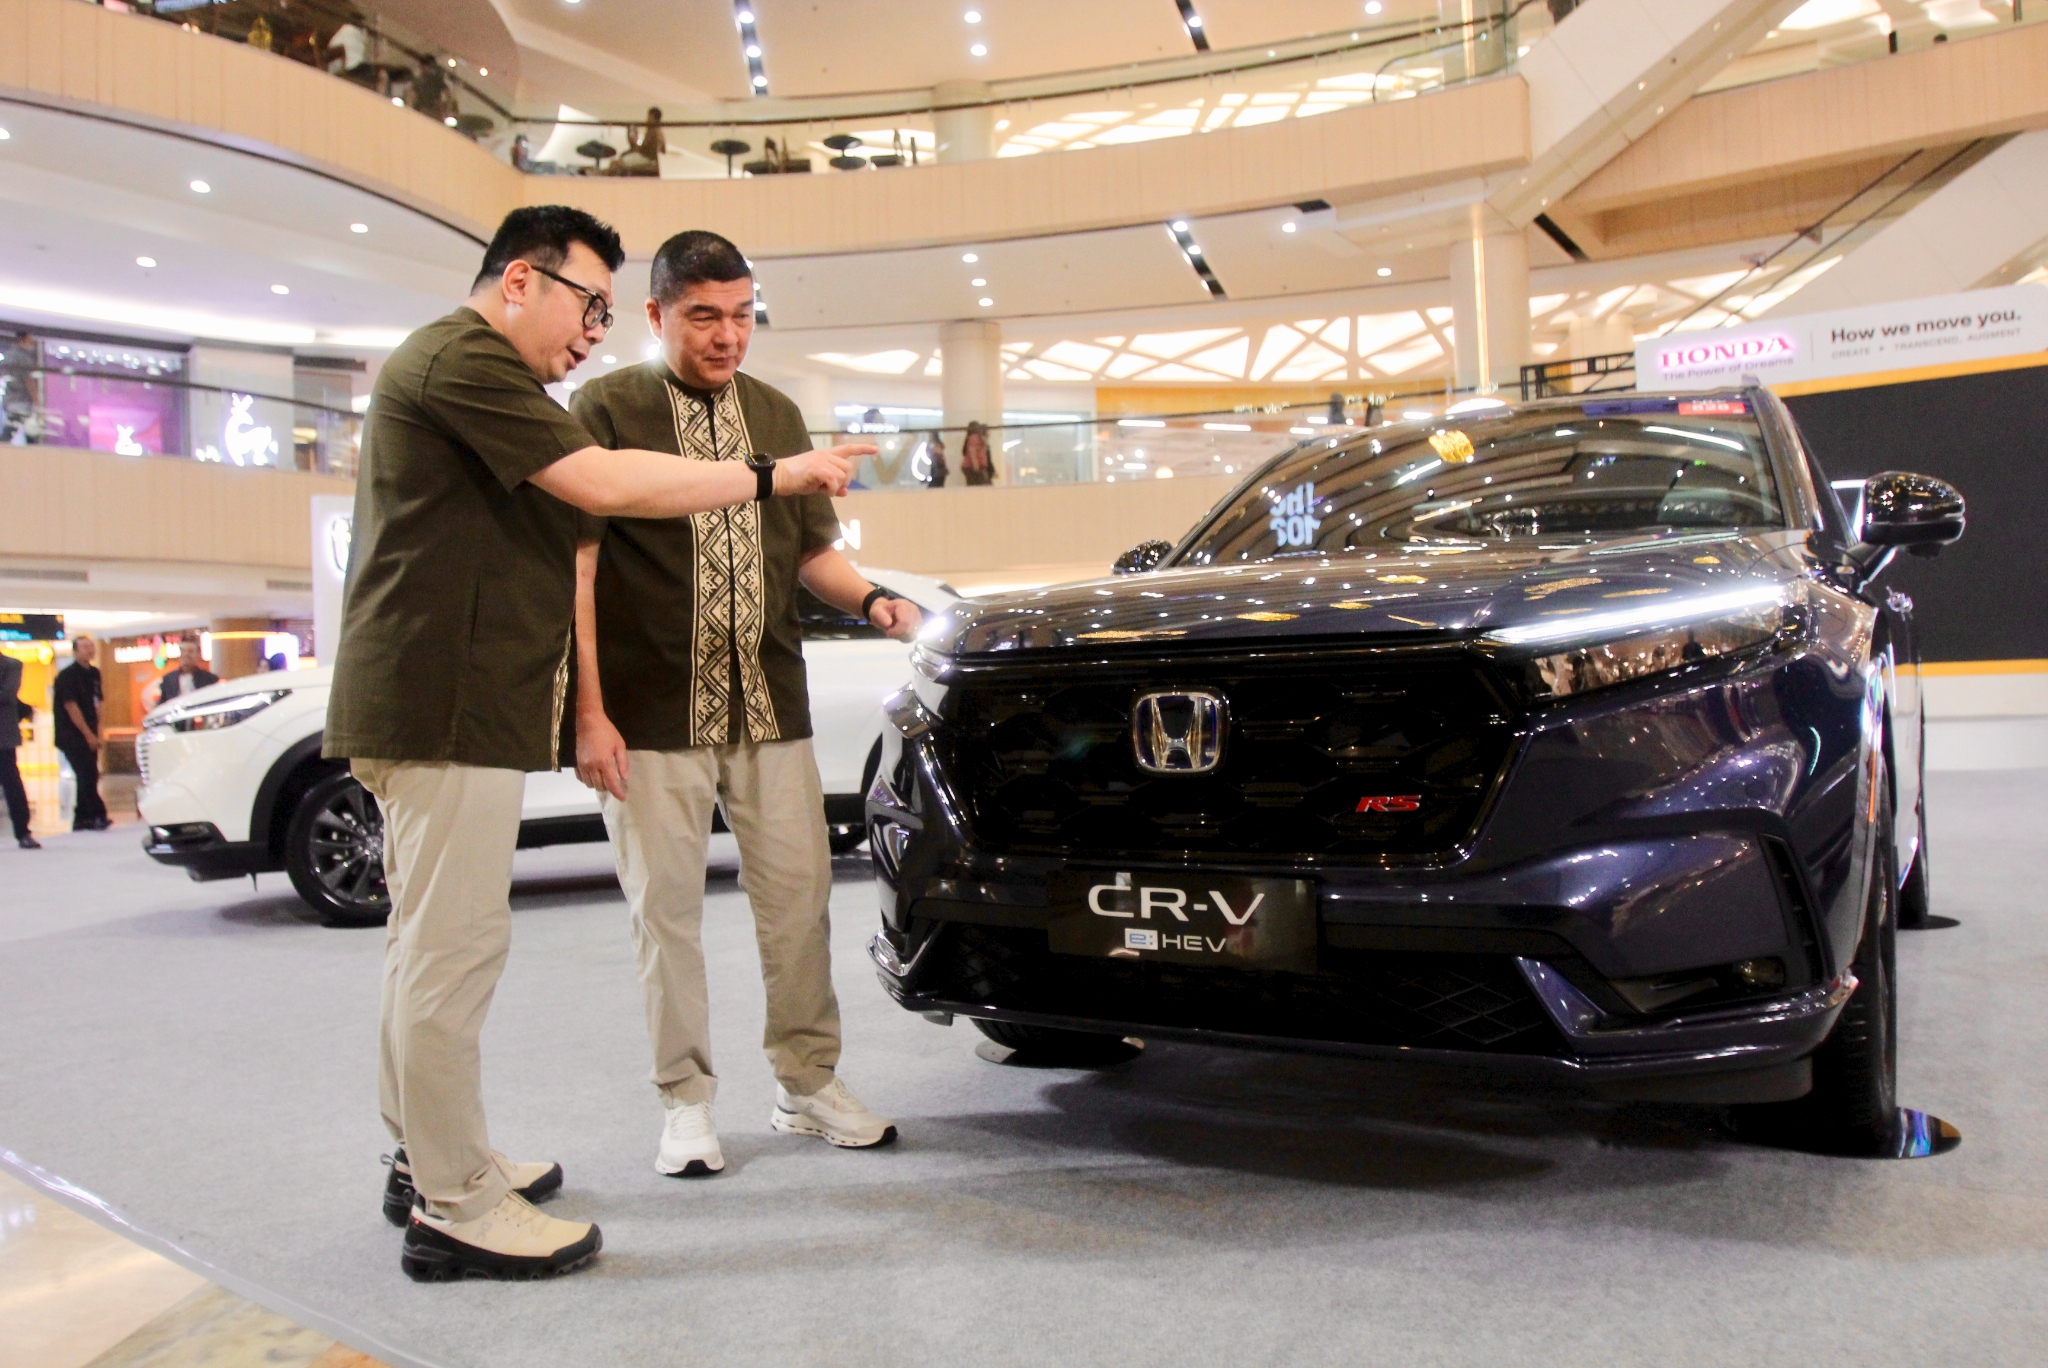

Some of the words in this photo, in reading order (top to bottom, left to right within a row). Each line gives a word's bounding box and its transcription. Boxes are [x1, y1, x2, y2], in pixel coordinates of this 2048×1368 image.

[1831, 327, 1875, 344] How
[1881, 323, 1910, 336] we
[1915, 314, 1972, 333] move
[1977, 309, 2022, 328] you.
[1662, 337, 1793, 367] HONDA
[1663, 371, 1685, 382] The
[1688, 366, 1725, 379] Power
[1729, 363, 1742, 372] of
[1745, 357, 1794, 370] Dreams
[1356, 795, 1422, 813] RS
[1088, 884, 1265, 926] CR-V
